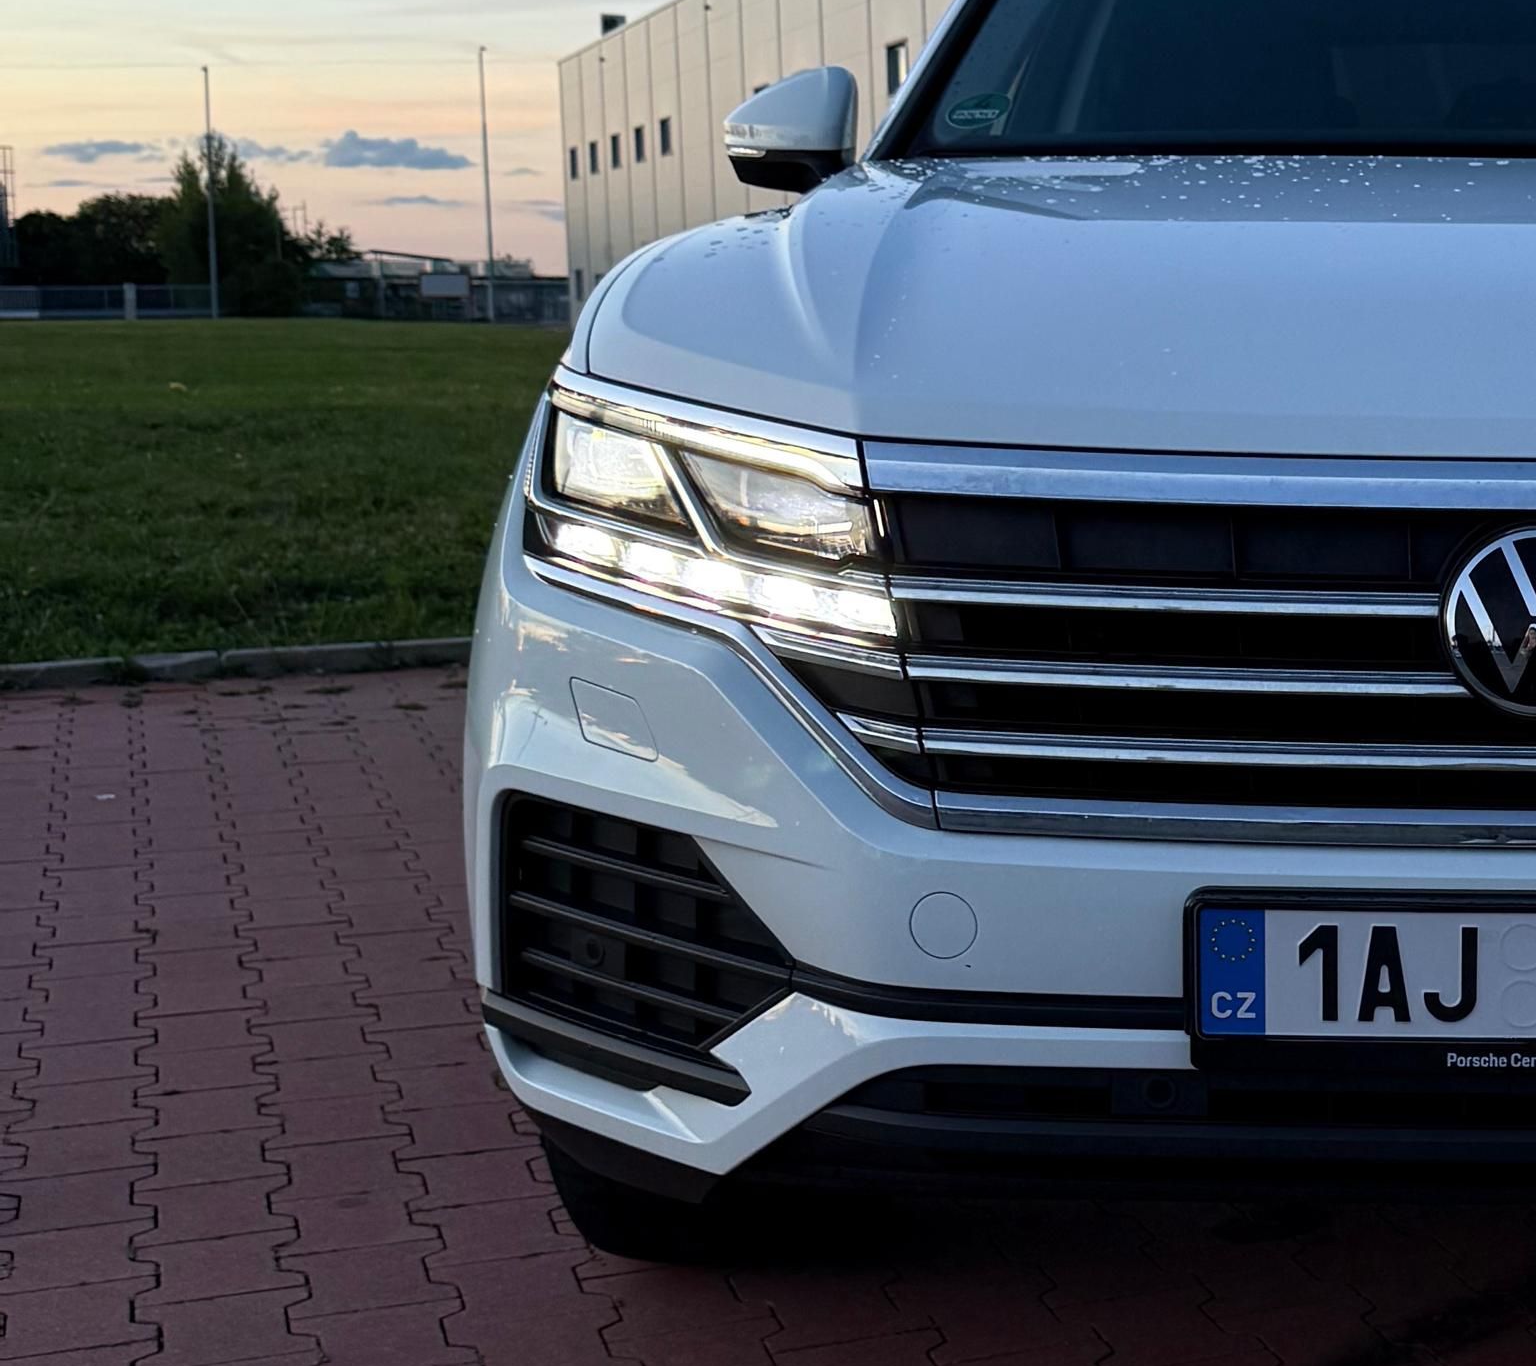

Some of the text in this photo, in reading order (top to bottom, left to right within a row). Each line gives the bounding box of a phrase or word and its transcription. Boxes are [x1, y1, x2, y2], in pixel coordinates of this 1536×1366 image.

[1210, 991, 1257, 1020] CZ
[1298, 924, 1478, 1023] 1AJ
[1446, 1052, 1507, 1068] Porsche
